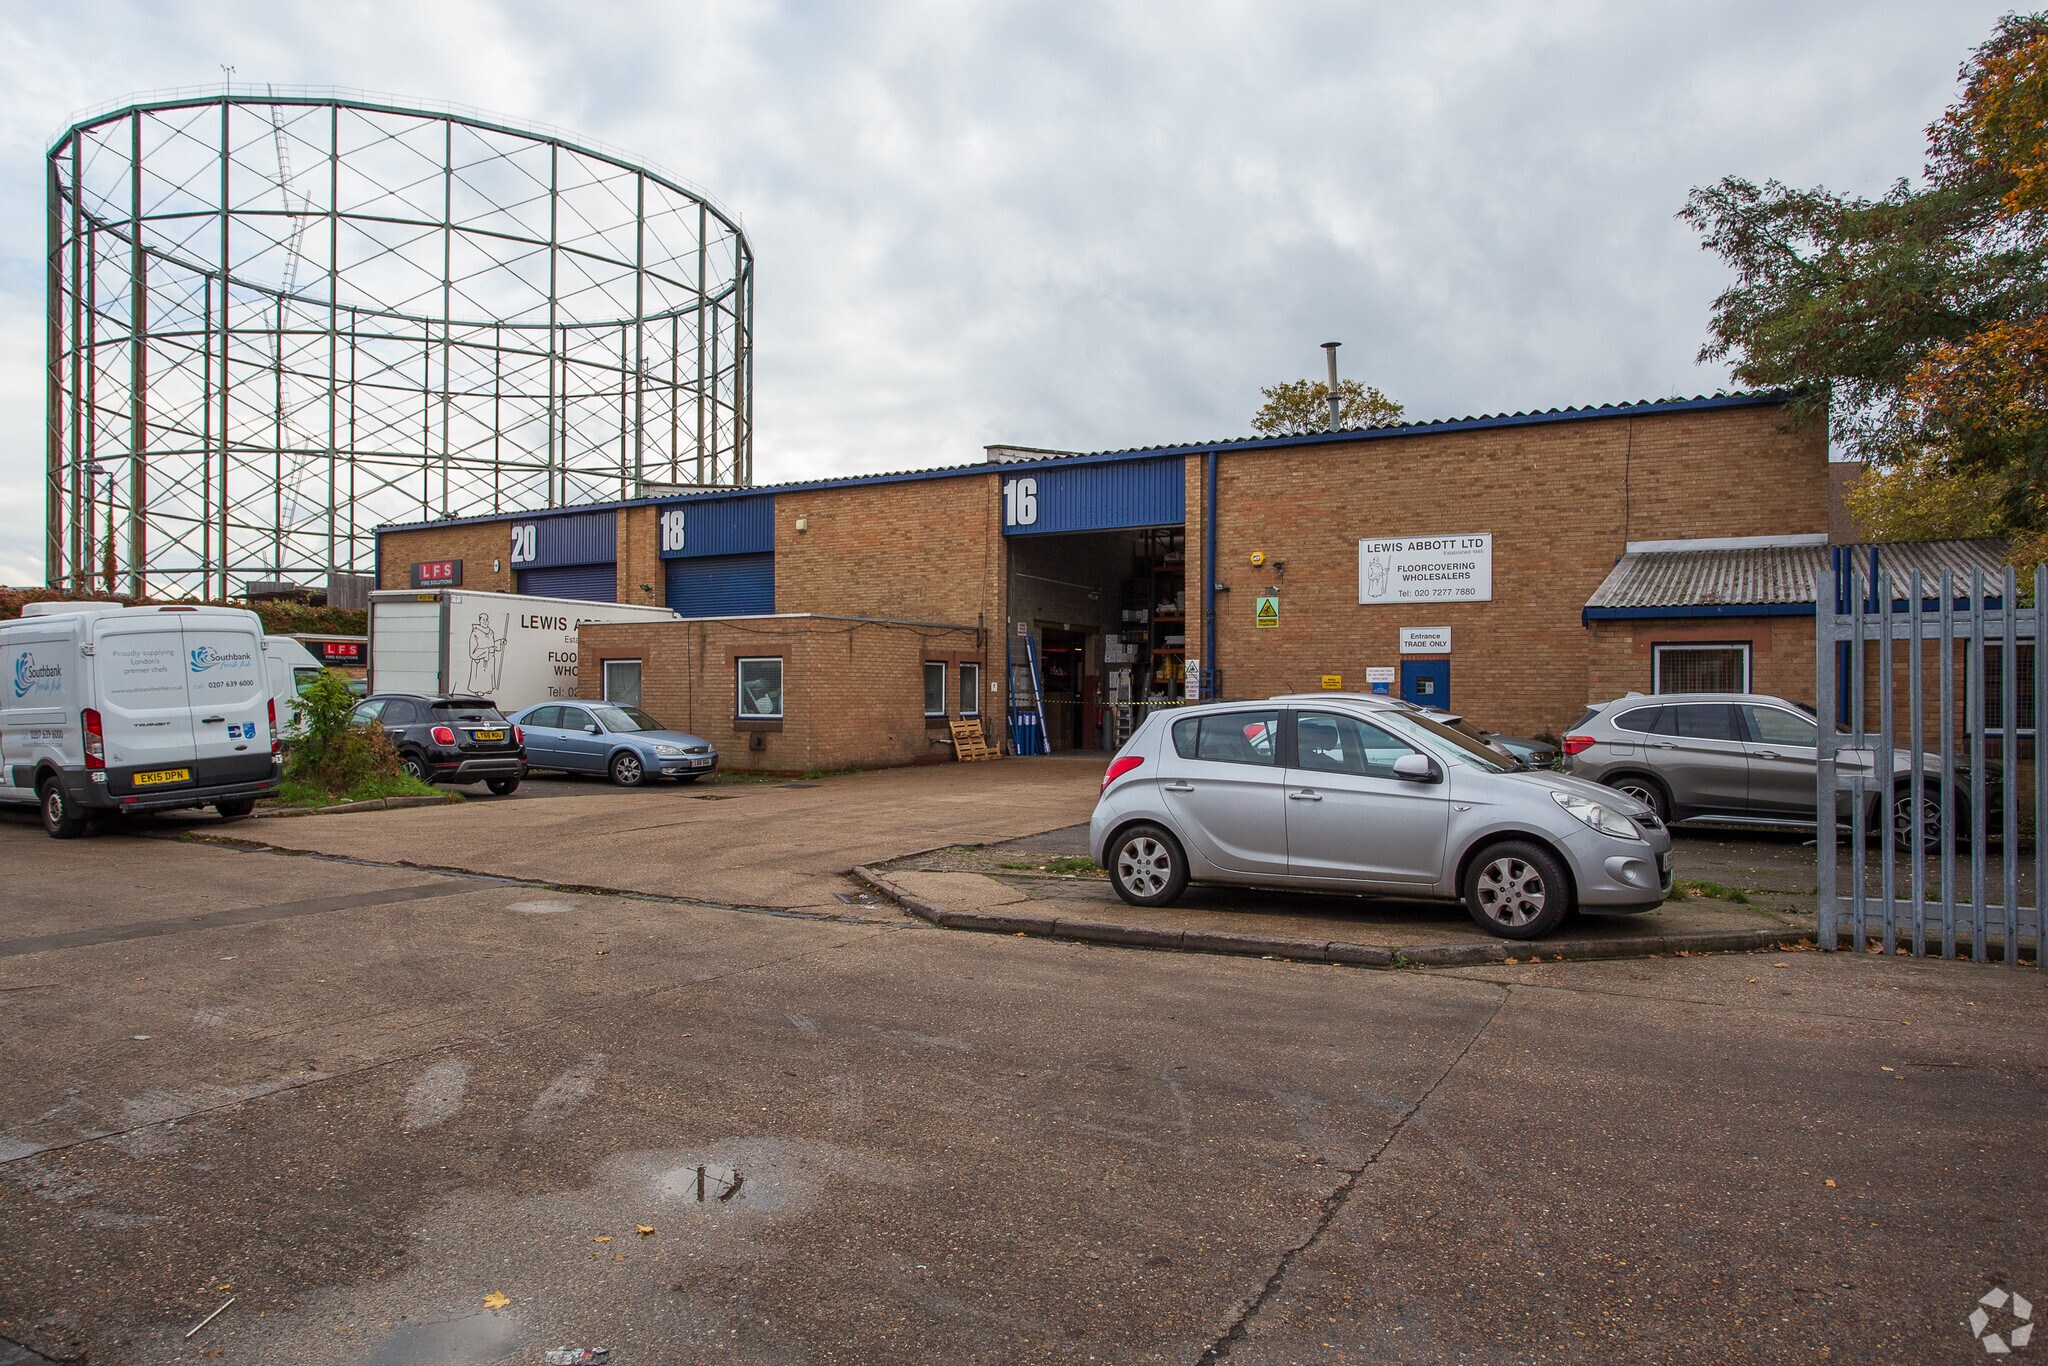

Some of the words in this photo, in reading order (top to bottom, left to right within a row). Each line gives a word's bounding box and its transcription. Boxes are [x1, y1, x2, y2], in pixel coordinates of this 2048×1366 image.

[1003, 477, 1038, 526] 16
[660, 510, 685, 551] 18
[511, 524, 537, 563] 20
[1367, 542, 1403, 553] LEWIS
[1408, 540, 1456, 550] ABBOTT
[1462, 539, 1483, 548] LTD
[1397, 562, 1476, 573] FLOORCOVERING
[1402, 572, 1471, 581] WHOLESALERS
[1398, 589, 1412, 597] Tel:
[1414, 589, 1430, 597] 020
[1432, 588, 1452, 596] 7277
[1455, 587, 1476, 595] 7880
[521, 614, 567, 631] LEWIS
[112, 650, 141, 658] Proudly
[143, 649, 175, 657] supplying
[210, 652, 251, 662] Southbank
[548, 652, 577, 662] FLOO
[28, 664, 62, 679] Southbank
[123, 667, 150, 675] premier
[554, 665, 578, 676] WHO
[208, 681, 224, 689] 0207
[225, 680, 238, 688] 639
[239, 679, 254, 687] 6000
[548, 686, 565, 697] Tel:
[568, 686, 578, 697] 02
[140, 773, 162, 783] EK15
[165, 772, 184, 781] DPN
